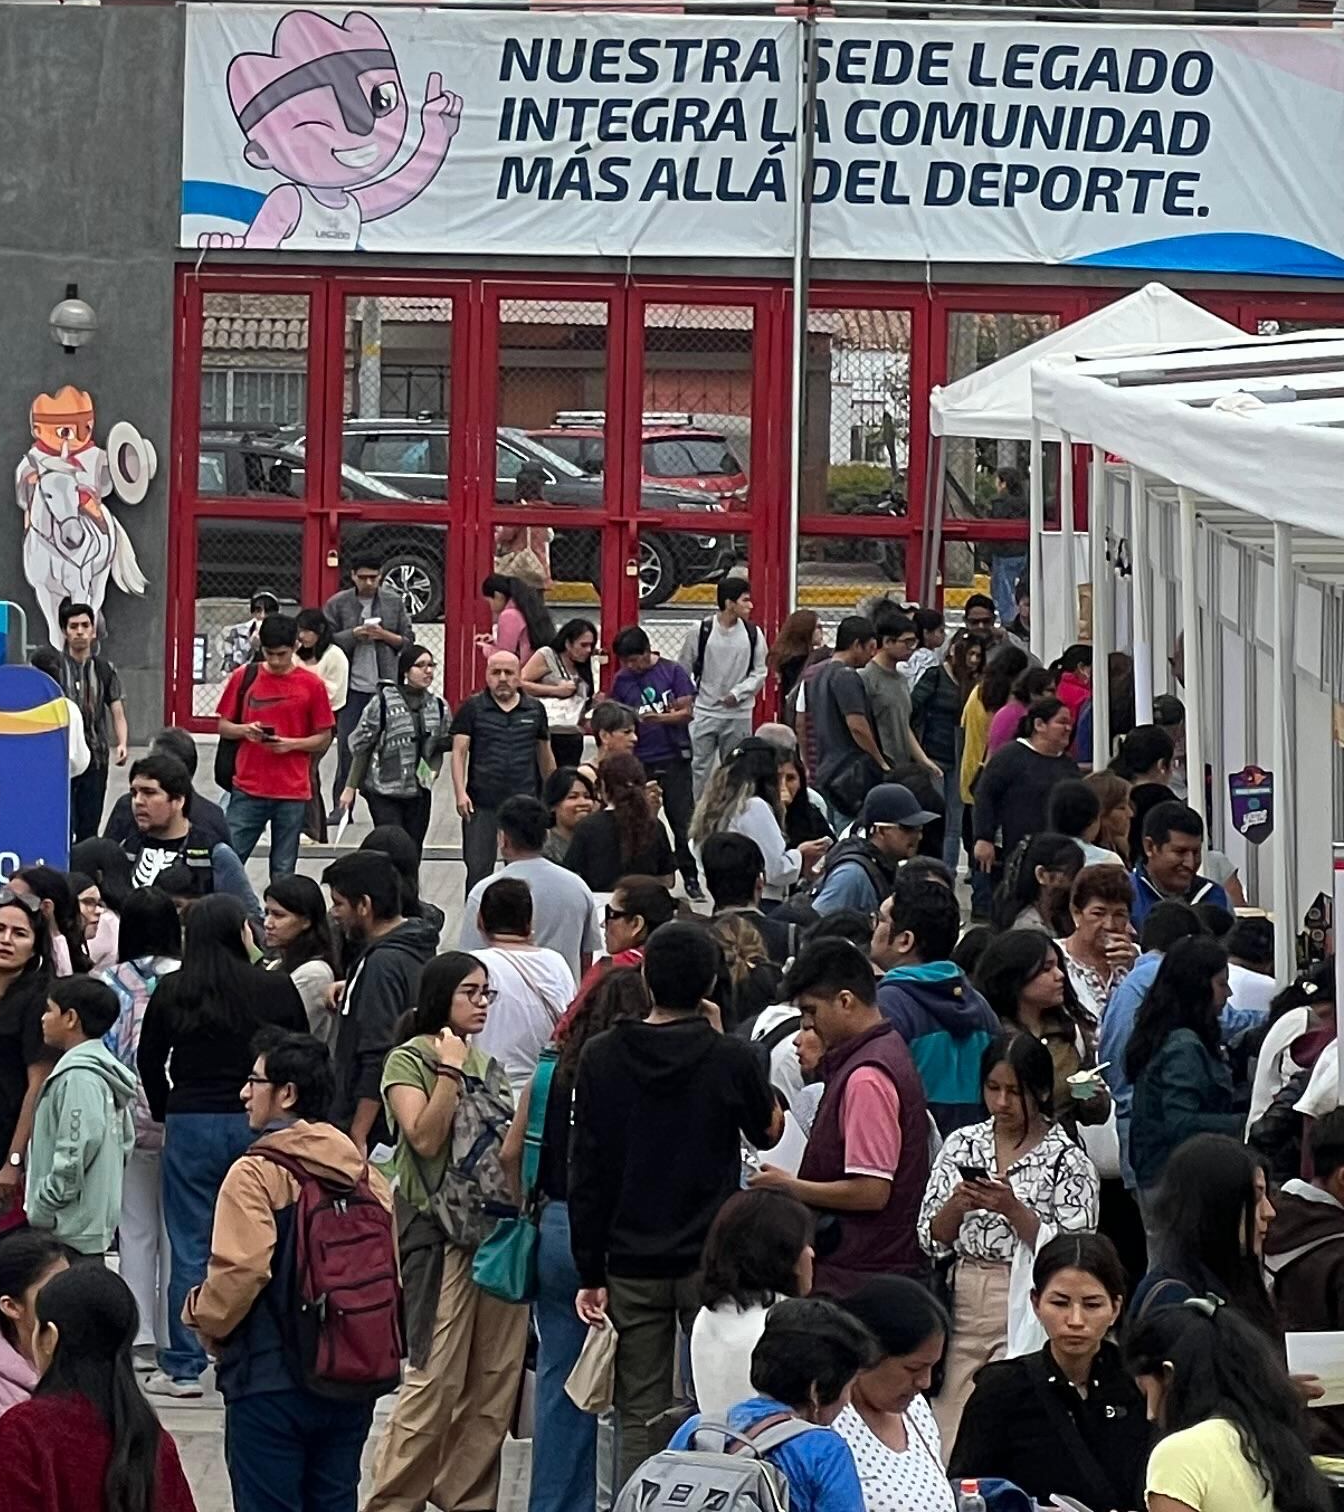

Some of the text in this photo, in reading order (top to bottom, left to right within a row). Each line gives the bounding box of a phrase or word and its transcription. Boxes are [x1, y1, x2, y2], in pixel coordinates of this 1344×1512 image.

[499, 38, 1213, 96] NUESTRA SEDE LEGADO
[498, 97, 1211, 156] INTEGRA LA COMUNIDAD
[497, 142, 1210, 218] MÁS ALLÁ DEL DEPORTE.
